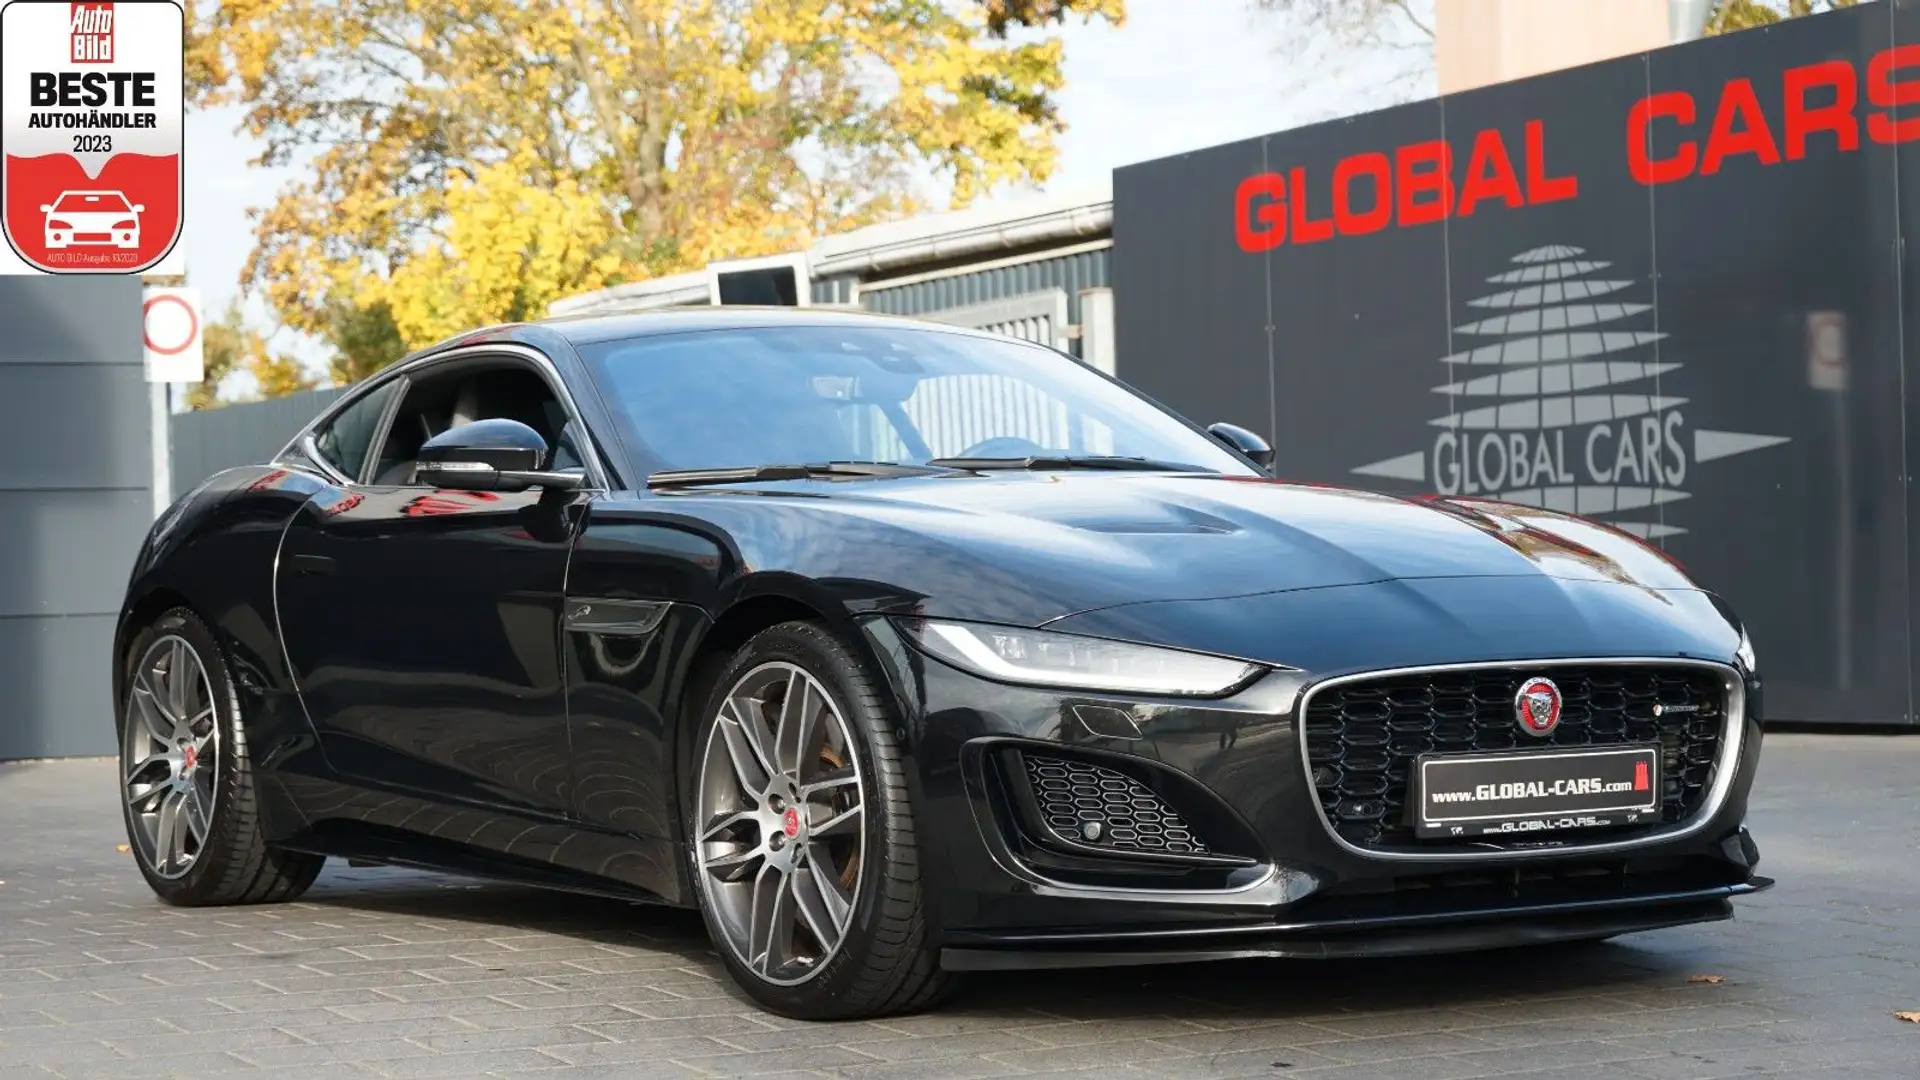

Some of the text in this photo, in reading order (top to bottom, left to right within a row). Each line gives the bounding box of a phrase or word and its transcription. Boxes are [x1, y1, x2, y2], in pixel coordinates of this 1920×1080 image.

[1235, 44, 1920, 253] GLOBAL CARS
[1433, 410, 1686, 495] GLOBAL CARS
[1432, 778, 1632, 803] www.GLOBAL-CARS.com
